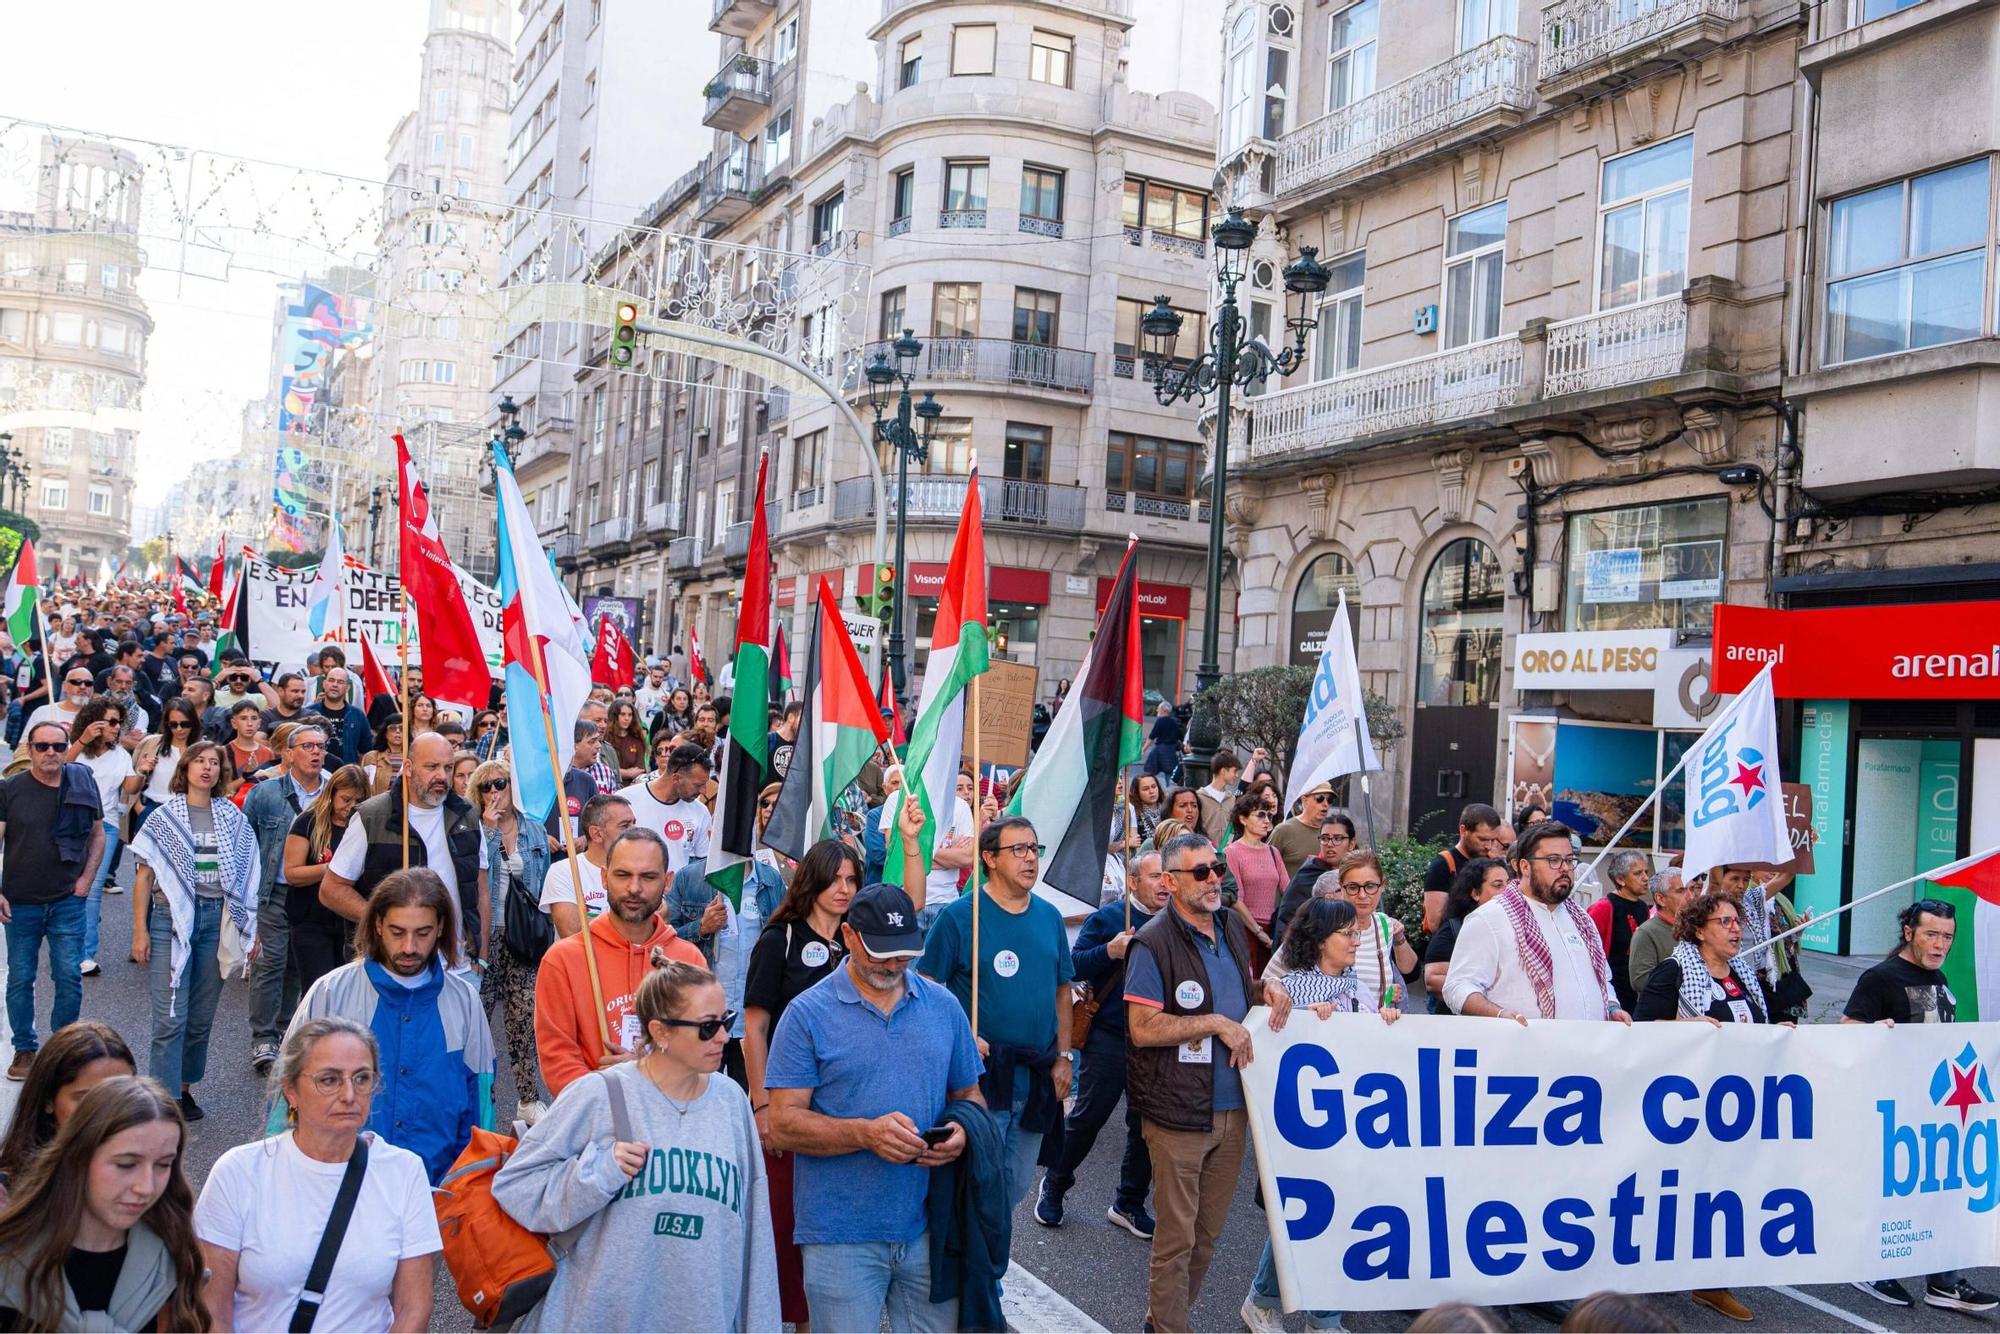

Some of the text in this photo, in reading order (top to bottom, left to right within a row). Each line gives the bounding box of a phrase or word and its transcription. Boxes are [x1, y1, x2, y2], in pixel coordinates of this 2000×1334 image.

[914, 573, 946, 585] Vision
[276, 584, 307, 608] EN
[1138, 594, 1167, 605] onLab!
[1522, 646, 1657, 673] ORO AL PESO
[1726, 643, 1784, 664] arenal
[1891, 644, 2000, 678] arenal
[1693, 717, 1740, 828] bng
[585, 888, 605, 903] aliza
[1181, 989, 1200, 1001] bng
[1274, 1043, 1813, 1150] Galiza con
[1877, 1100, 2000, 1213] bng
[658, 1214, 699, 1237] U.S.A.
[1275, 1169, 1817, 1281] Palestina
[1882, 1219, 1912, 1233] BLOQUE
[1881, 1230, 1933, 1246] NACIONALISTA
[1881, 1246, 1912, 1259] GALEGO
